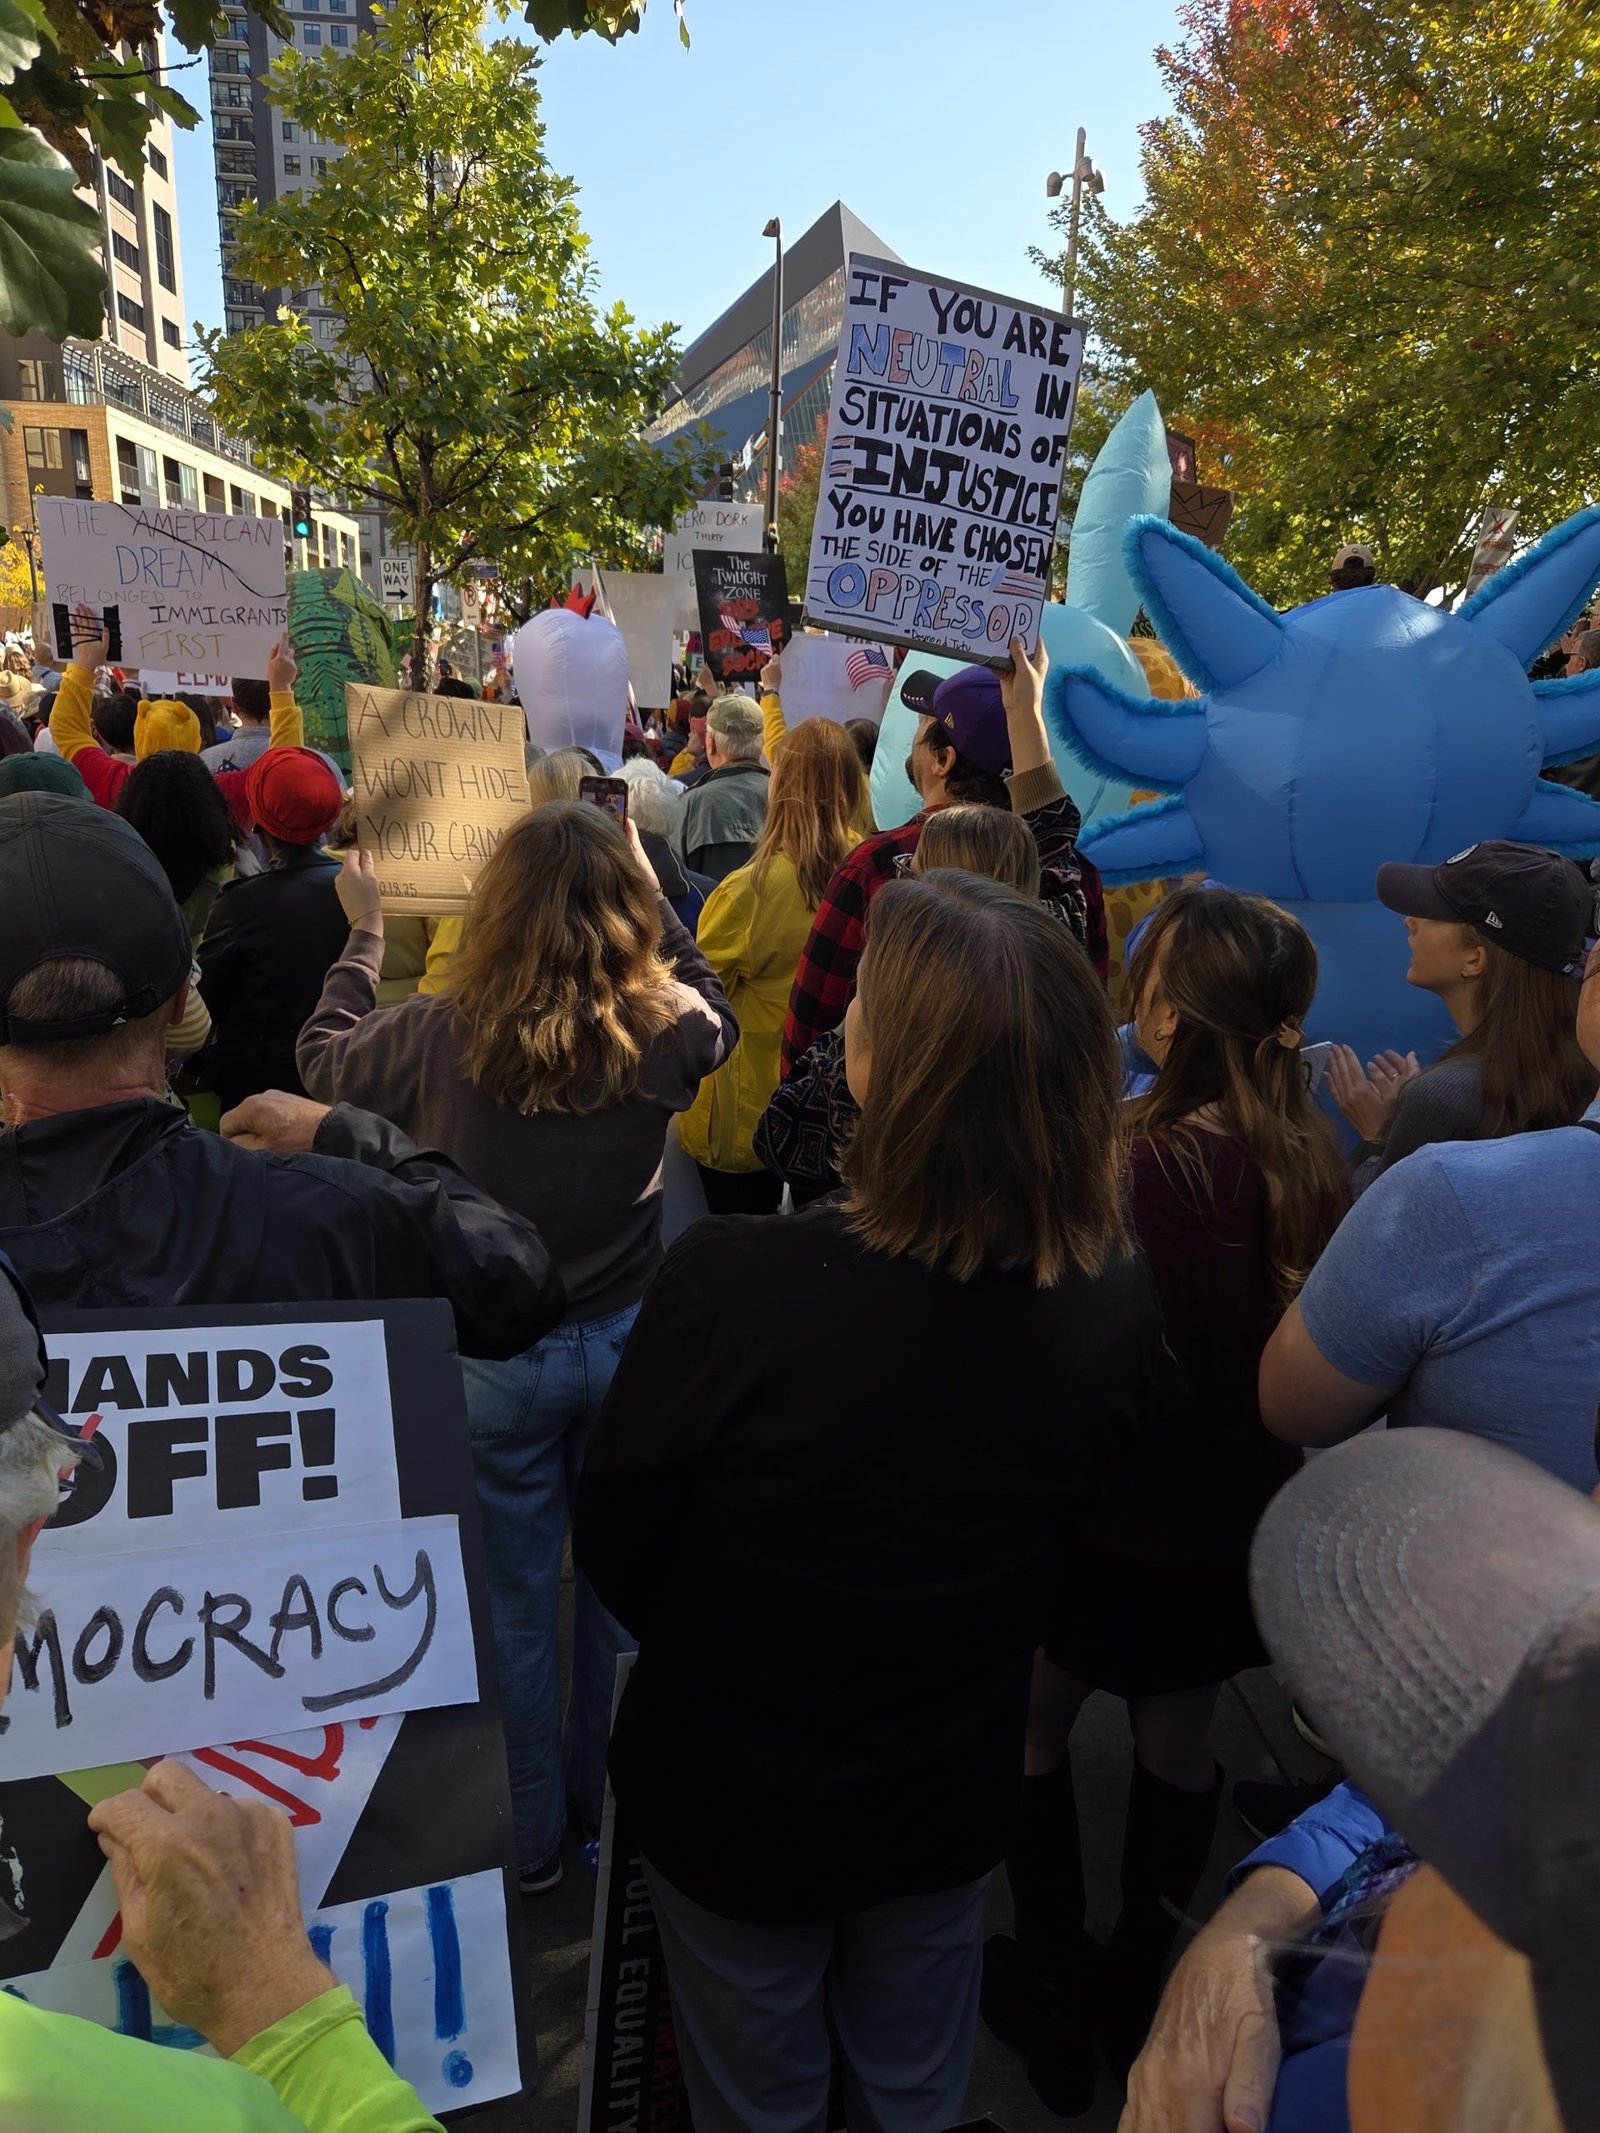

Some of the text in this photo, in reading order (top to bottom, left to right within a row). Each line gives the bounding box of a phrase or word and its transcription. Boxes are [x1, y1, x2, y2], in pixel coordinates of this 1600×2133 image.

[850, 271, 1072, 367] IF YOU ARE
[847, 323, 1072, 420] NEUTRAL IN
[838, 386, 1068, 468] SITUATIONS OF
[47, 501, 272, 547] THE AMERICAN
[679, 510, 748, 528] ERO DORK
[695, 531, 724, 542] THIRTY
[827, 488, 1054, 580] YOU HAVE CHOSEN
[115, 545, 227, 590] DREAM
[383, 562, 408, 573] ONE
[383, 575, 409, 586] WAY
[713, 567, 768, 586] TWILIGHT
[728, 556, 751, 570] The
[820, 535, 992, 587] THE SIDE OF THE
[56, 583, 203, 604] BELONGED TO
[723, 585, 761, 600] ZONE
[827, 562, 1033, 650] OPPRESSOR
[149, 605, 287, 626] IMMIGRANTS
[138, 629, 225, 660] FIRST
[357, 692, 503, 742] A CROWN
[457, 763, 526, 803] HIDE
[365, 814, 508, 862] YOUR CRIM
[0, 1548, 437, 1735] MOCRACY
